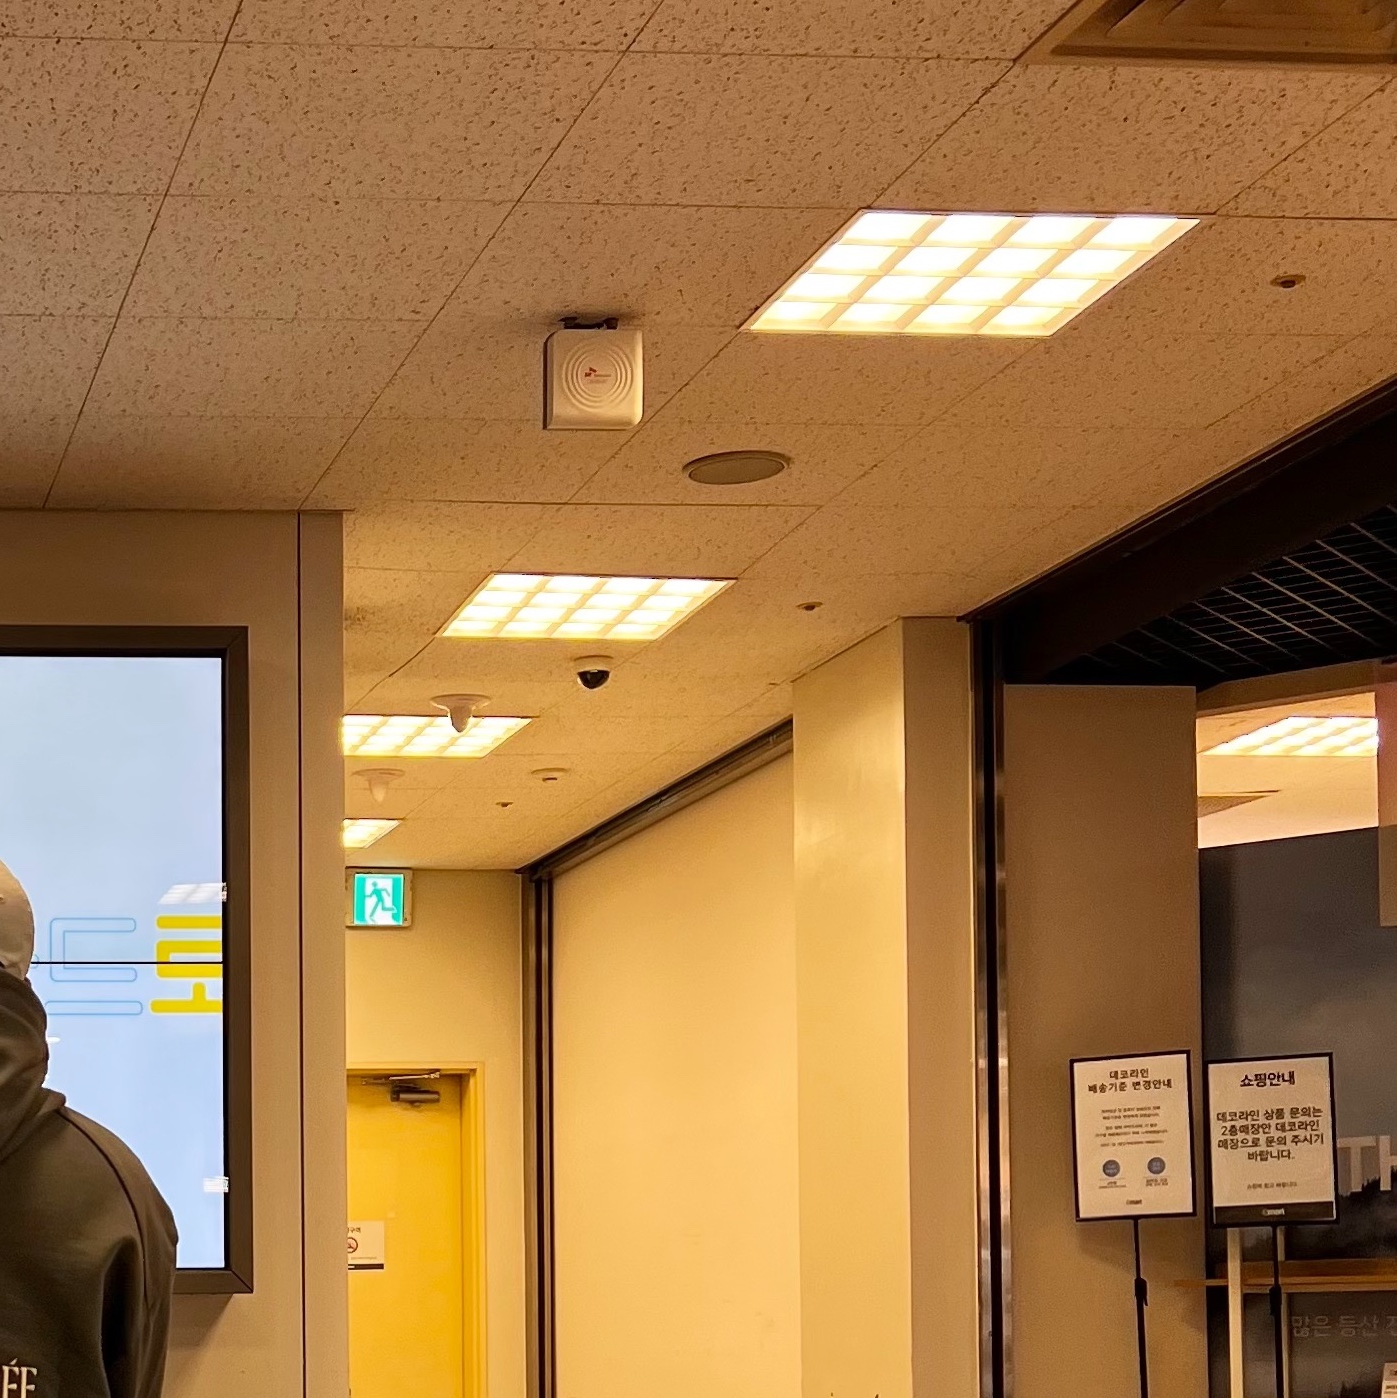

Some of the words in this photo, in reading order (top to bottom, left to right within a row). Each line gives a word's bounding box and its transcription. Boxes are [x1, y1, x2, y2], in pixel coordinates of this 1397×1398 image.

[1132, 1079, 1172, 1090] 변경안내
[1240, 1070, 1295, 1087] 쇼핑안내
[1216, 1109, 1260, 1122] 데코라인
[1263, 1107, 1285, 1120] 상품
[1289, 1106, 1323, 1119] 문의는
[1275, 1120, 1319, 1133] 데코라인
[1217, 1137, 1261, 1150] 매장으로
[1265, 1135, 1287, 1147] 문의
[1291, 1133, 1324, 1146] 주시기
